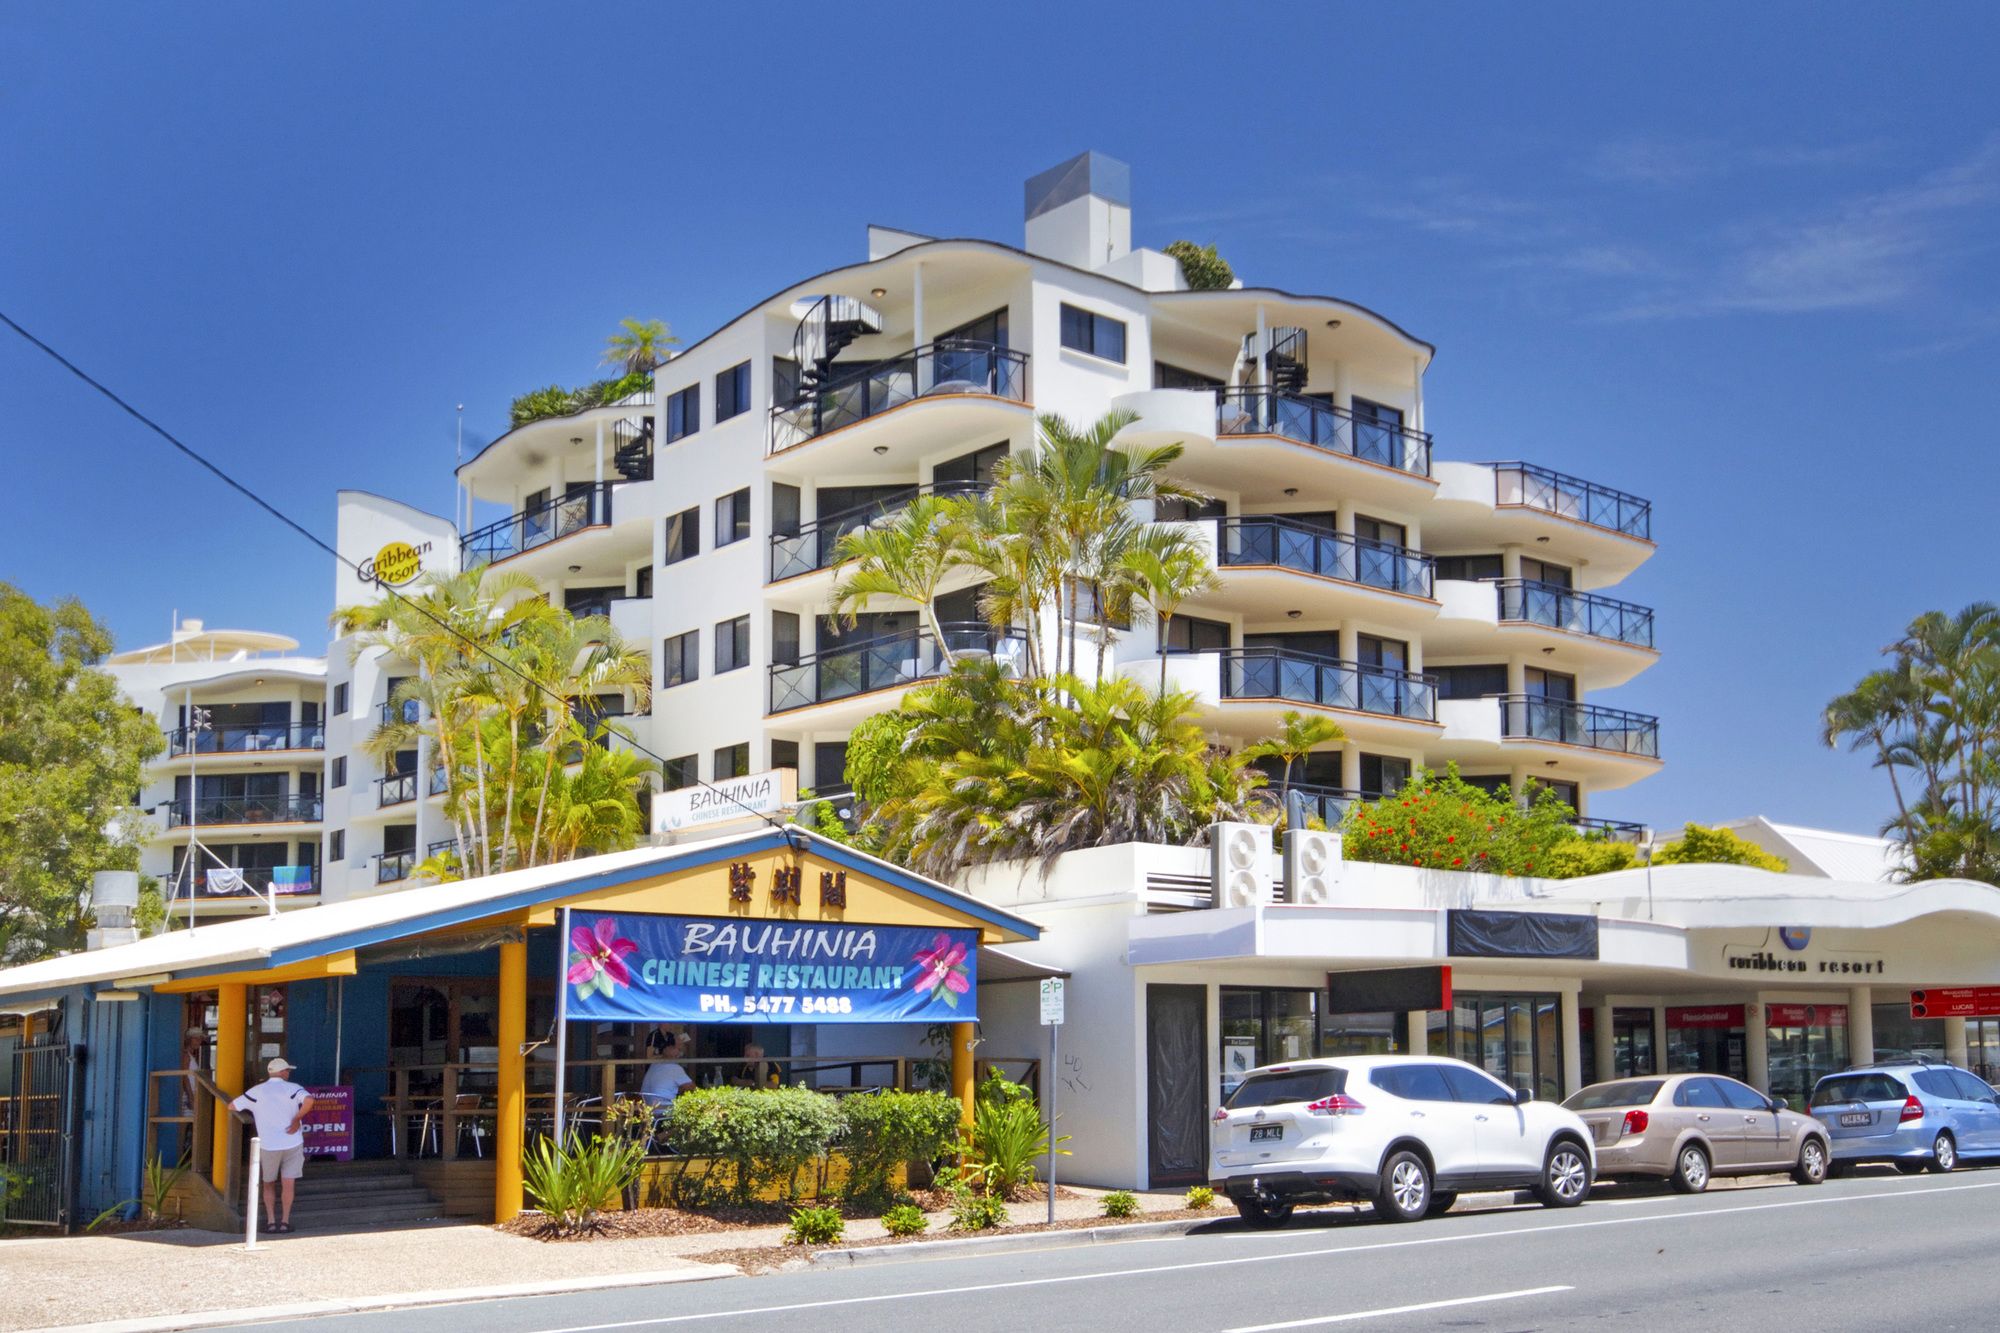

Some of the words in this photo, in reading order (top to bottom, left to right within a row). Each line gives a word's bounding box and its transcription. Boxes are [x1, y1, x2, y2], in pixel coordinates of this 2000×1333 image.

[357, 541, 432, 582] Caribbean
[375, 559, 423, 591] Resort
[690, 779, 771, 811] BAUHINIA
[692, 809, 720, 822] CHINESE
[721, 800, 768, 817] RESTAURANT
[681, 923, 877, 960] BAUHINIA
[642, 959, 750, 988] CHINESE
[757, 963, 904, 990] RESTAURANT
[1729, 952, 1807, 972] caribbean
[1819, 960, 1884, 973] resort
[700, 994, 738, 1014] PH.
[743, 995, 796, 1014] 5477
[801, 996, 852, 1014] 5488
[1682, 1012, 1728, 1022] Residential
[302, 1123, 346, 1132] OPEN
